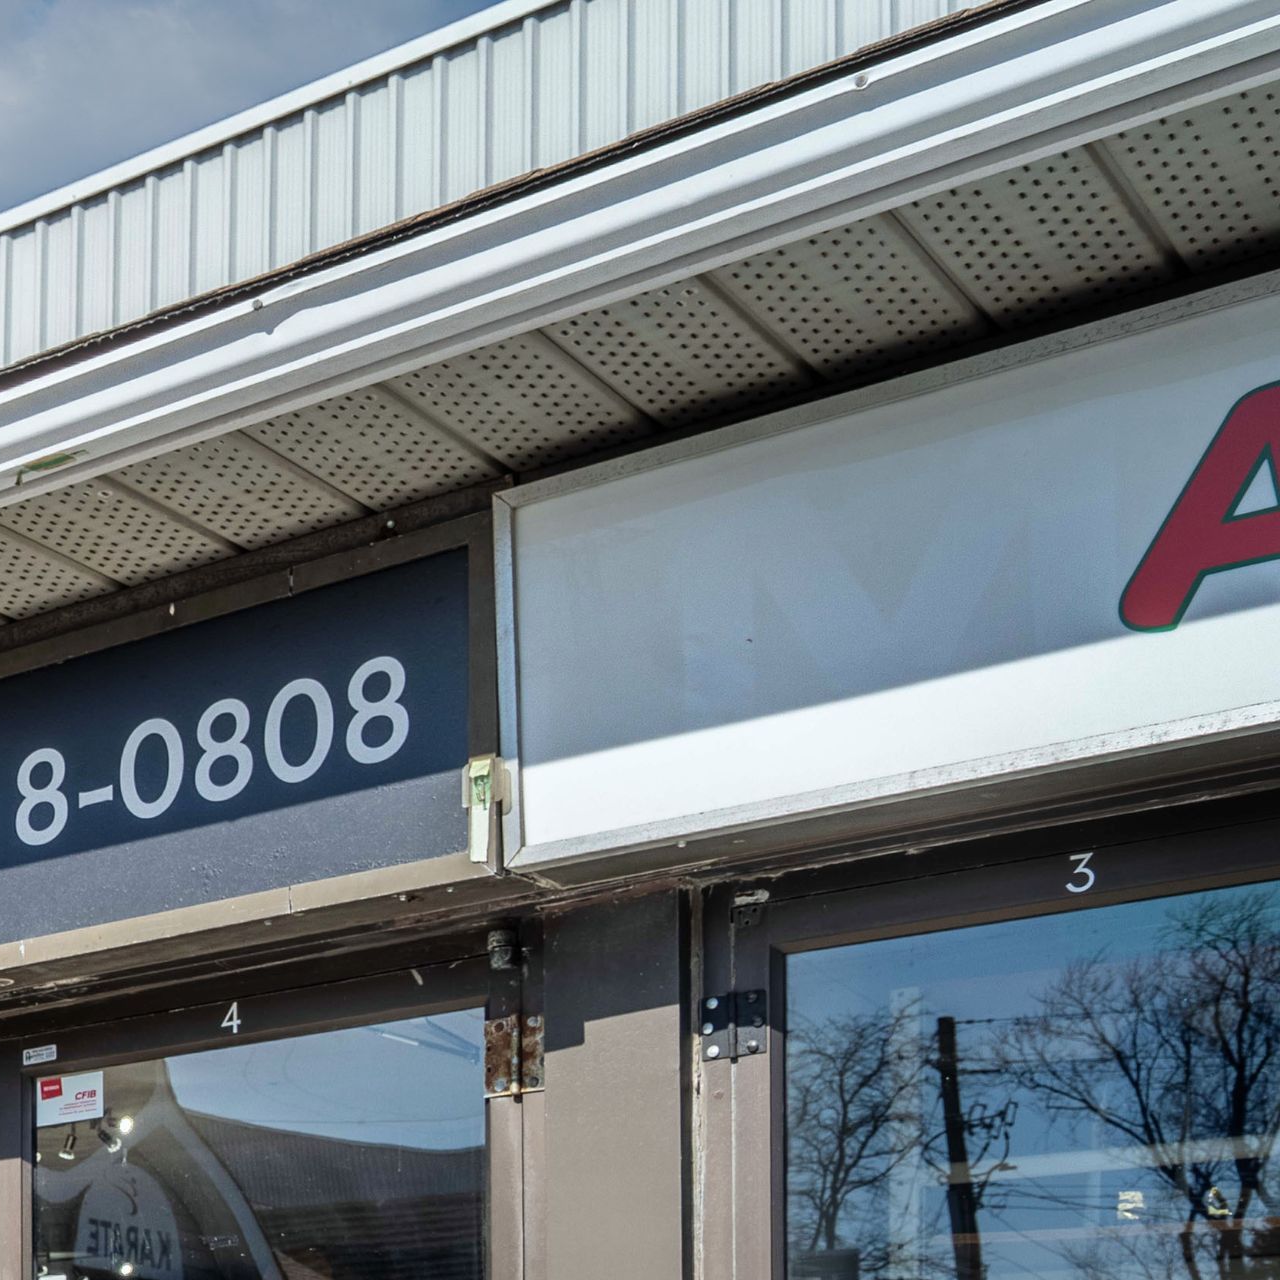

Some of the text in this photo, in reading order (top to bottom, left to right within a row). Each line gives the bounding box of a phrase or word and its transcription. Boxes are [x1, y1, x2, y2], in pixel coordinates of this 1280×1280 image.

[1064, 852, 1096, 893] 3
[220, 1001, 242, 1034] 4
[75, 1089, 97, 1101] CFIB
